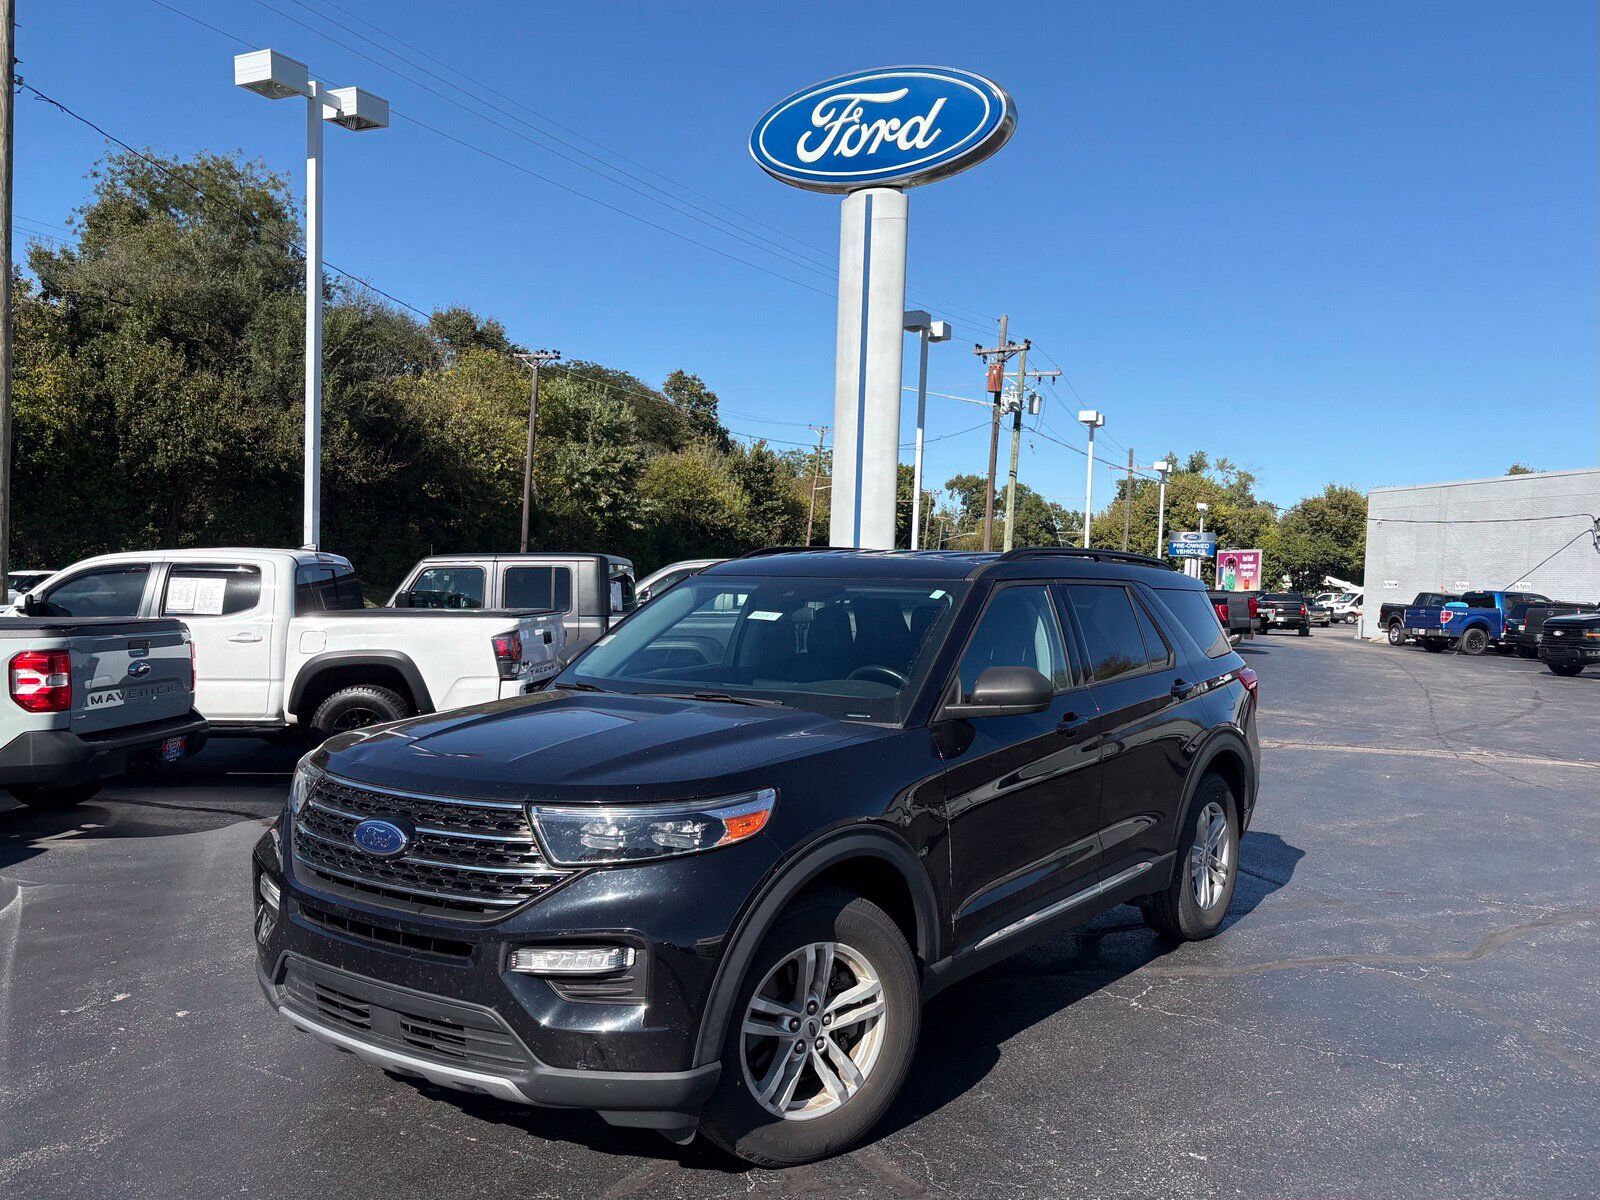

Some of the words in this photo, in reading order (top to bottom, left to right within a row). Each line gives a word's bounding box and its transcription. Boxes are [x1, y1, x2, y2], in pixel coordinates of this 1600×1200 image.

[796, 87, 948, 164] Ford
[530, 664, 555, 675] TACOMA
[90, 684, 176, 705] MAVERICK
